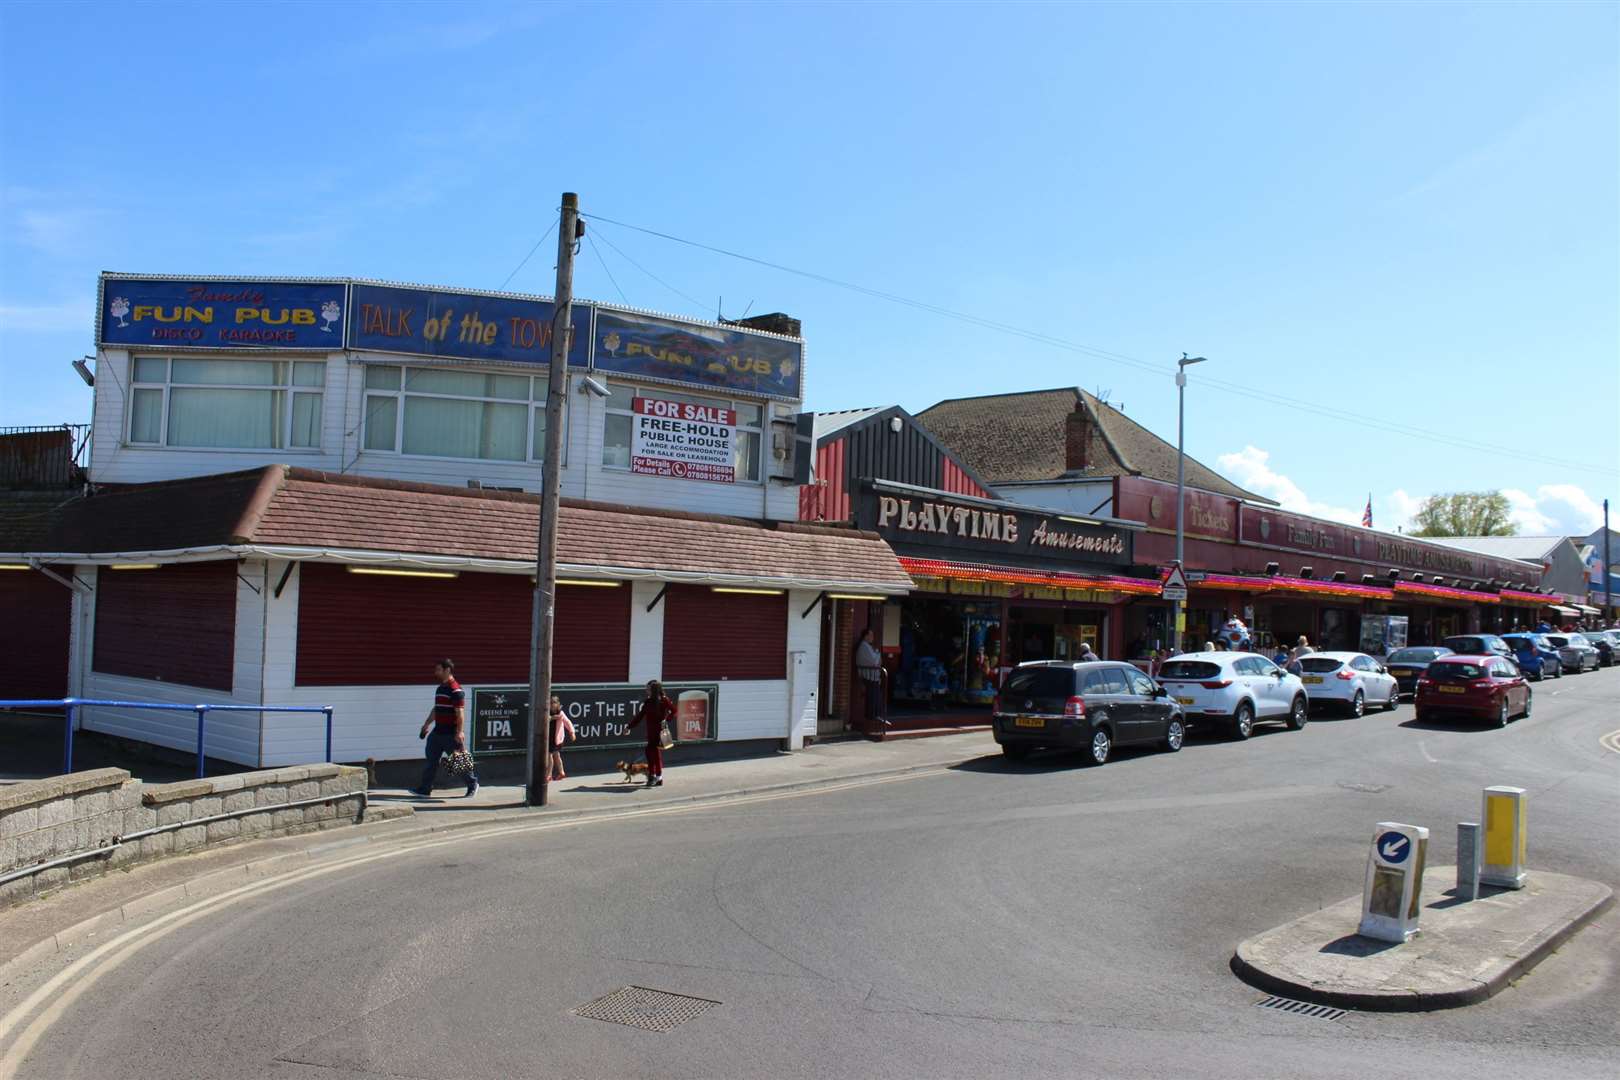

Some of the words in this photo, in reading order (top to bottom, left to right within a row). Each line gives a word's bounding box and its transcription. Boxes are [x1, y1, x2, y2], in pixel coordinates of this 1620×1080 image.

[133, 305, 214, 324] FUN
[235, 307, 317, 325] PUB
[362, 303, 413, 337] TALK
[423, 309, 453, 342] of
[459, 311, 498, 346] the
[152, 328, 203, 341] DISCO
[218, 328, 297, 342] KARAOKE
[643, 399, 680, 419] FOR
[684, 404, 729, 425] SALE
[640, 417, 730, 439] FREE-HOLD
[640, 430, 685, 444] PUBLIC
[688, 436, 729, 450] HOUSE
[646, 442, 668, 450] LARGE
[633, 457, 645, 465] For
[646, 458, 671, 469] Details
[641, 448, 656, 456] FOR
[657, 449, 675, 458] SALE
[687, 453, 727, 464] LEASEHOLD
[633, 465, 656, 474] Please
[658, 467, 672, 477] Call
[877, 495, 1019, 543] PLAYTIME
[1030, 519, 1124, 555] Amusements
[486, 720, 513, 738] IPA
[685, 720, 701, 732] IPA
